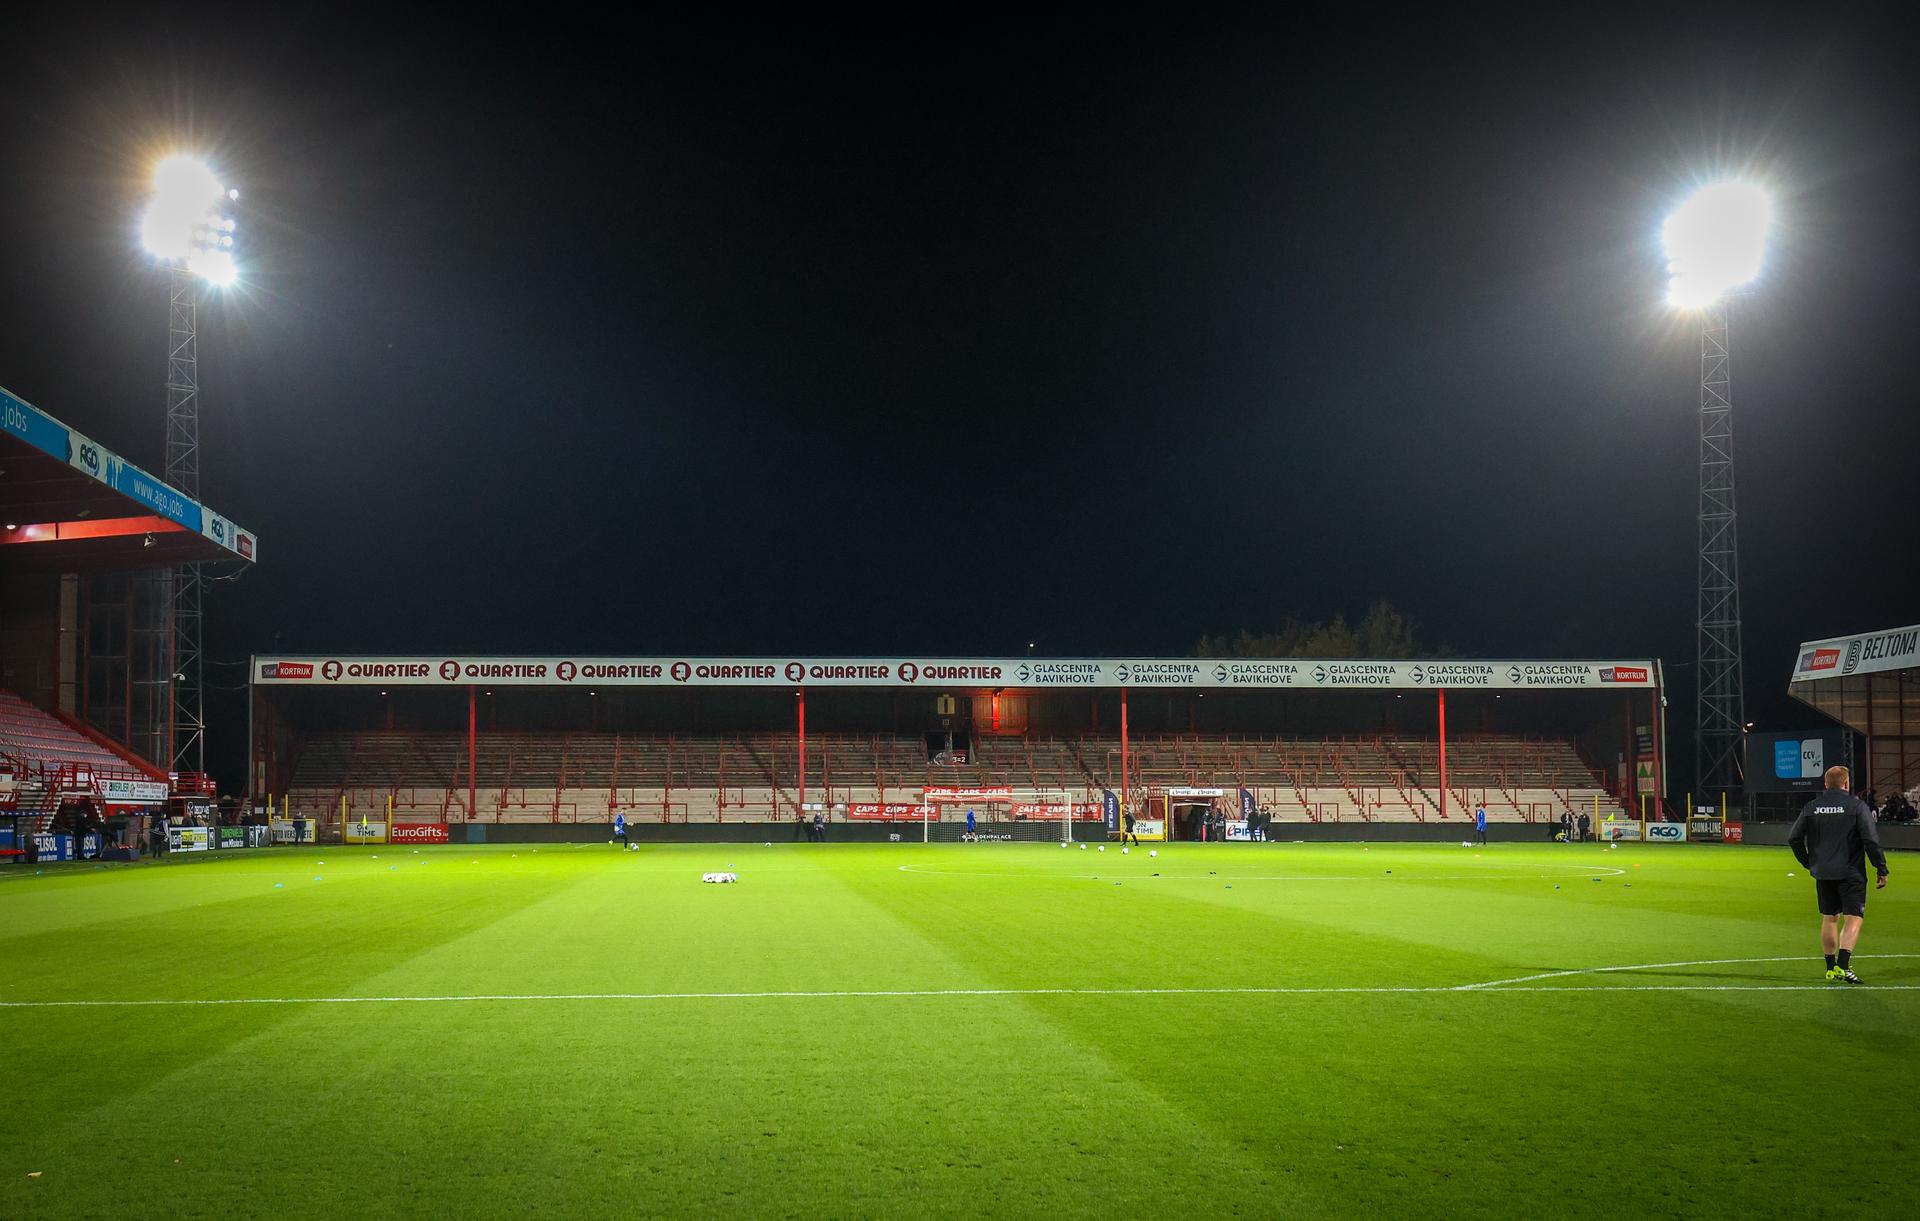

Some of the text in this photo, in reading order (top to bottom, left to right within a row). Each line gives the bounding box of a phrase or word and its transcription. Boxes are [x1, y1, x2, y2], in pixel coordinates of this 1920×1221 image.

[133, 479, 184, 518] www.ago.jobs
[1862, 631, 1918, 660] BELTONA
[279, 667, 311, 676] KORTRIJK
[347, 663, 430, 678] QUARTIER
[464, 664, 547, 678] QUARTIER
[581, 664, 663, 678] QUARTIER
[695, 664, 776, 679] QUARTIER
[809, 664, 890, 679] QUARTIER
[922, 665, 1002, 680] QUARTIER
[1033, 664, 1101, 674] GLASCENTRA
[1132, 664, 1200, 674] GLASCENTRA
[1230, 664, 1298, 674] GLASCENTRA
[1329, 665, 1396, 675] GLASCENTRA
[1427, 665, 1494, 675] GLASCENTRA
[1524, 665, 1591, 675] GLASCENTRA
[1035, 674, 1095, 684] BAVIKHOVE
[1135, 674, 1194, 684] BAVIKHOVE
[1233, 674, 1292, 684] BAVIKHOVE
[1331, 675, 1390, 684] BAVIKHOVE
[1429, 675, 1488, 684] BAVIKHOVE
[1527, 675, 1586, 684] BAVIKHOVE
[1616, 671, 1646, 680] KORTRIJK
[392, 826, 442, 837] EuroGifts
[1650, 826, 1678, 836] AGO
